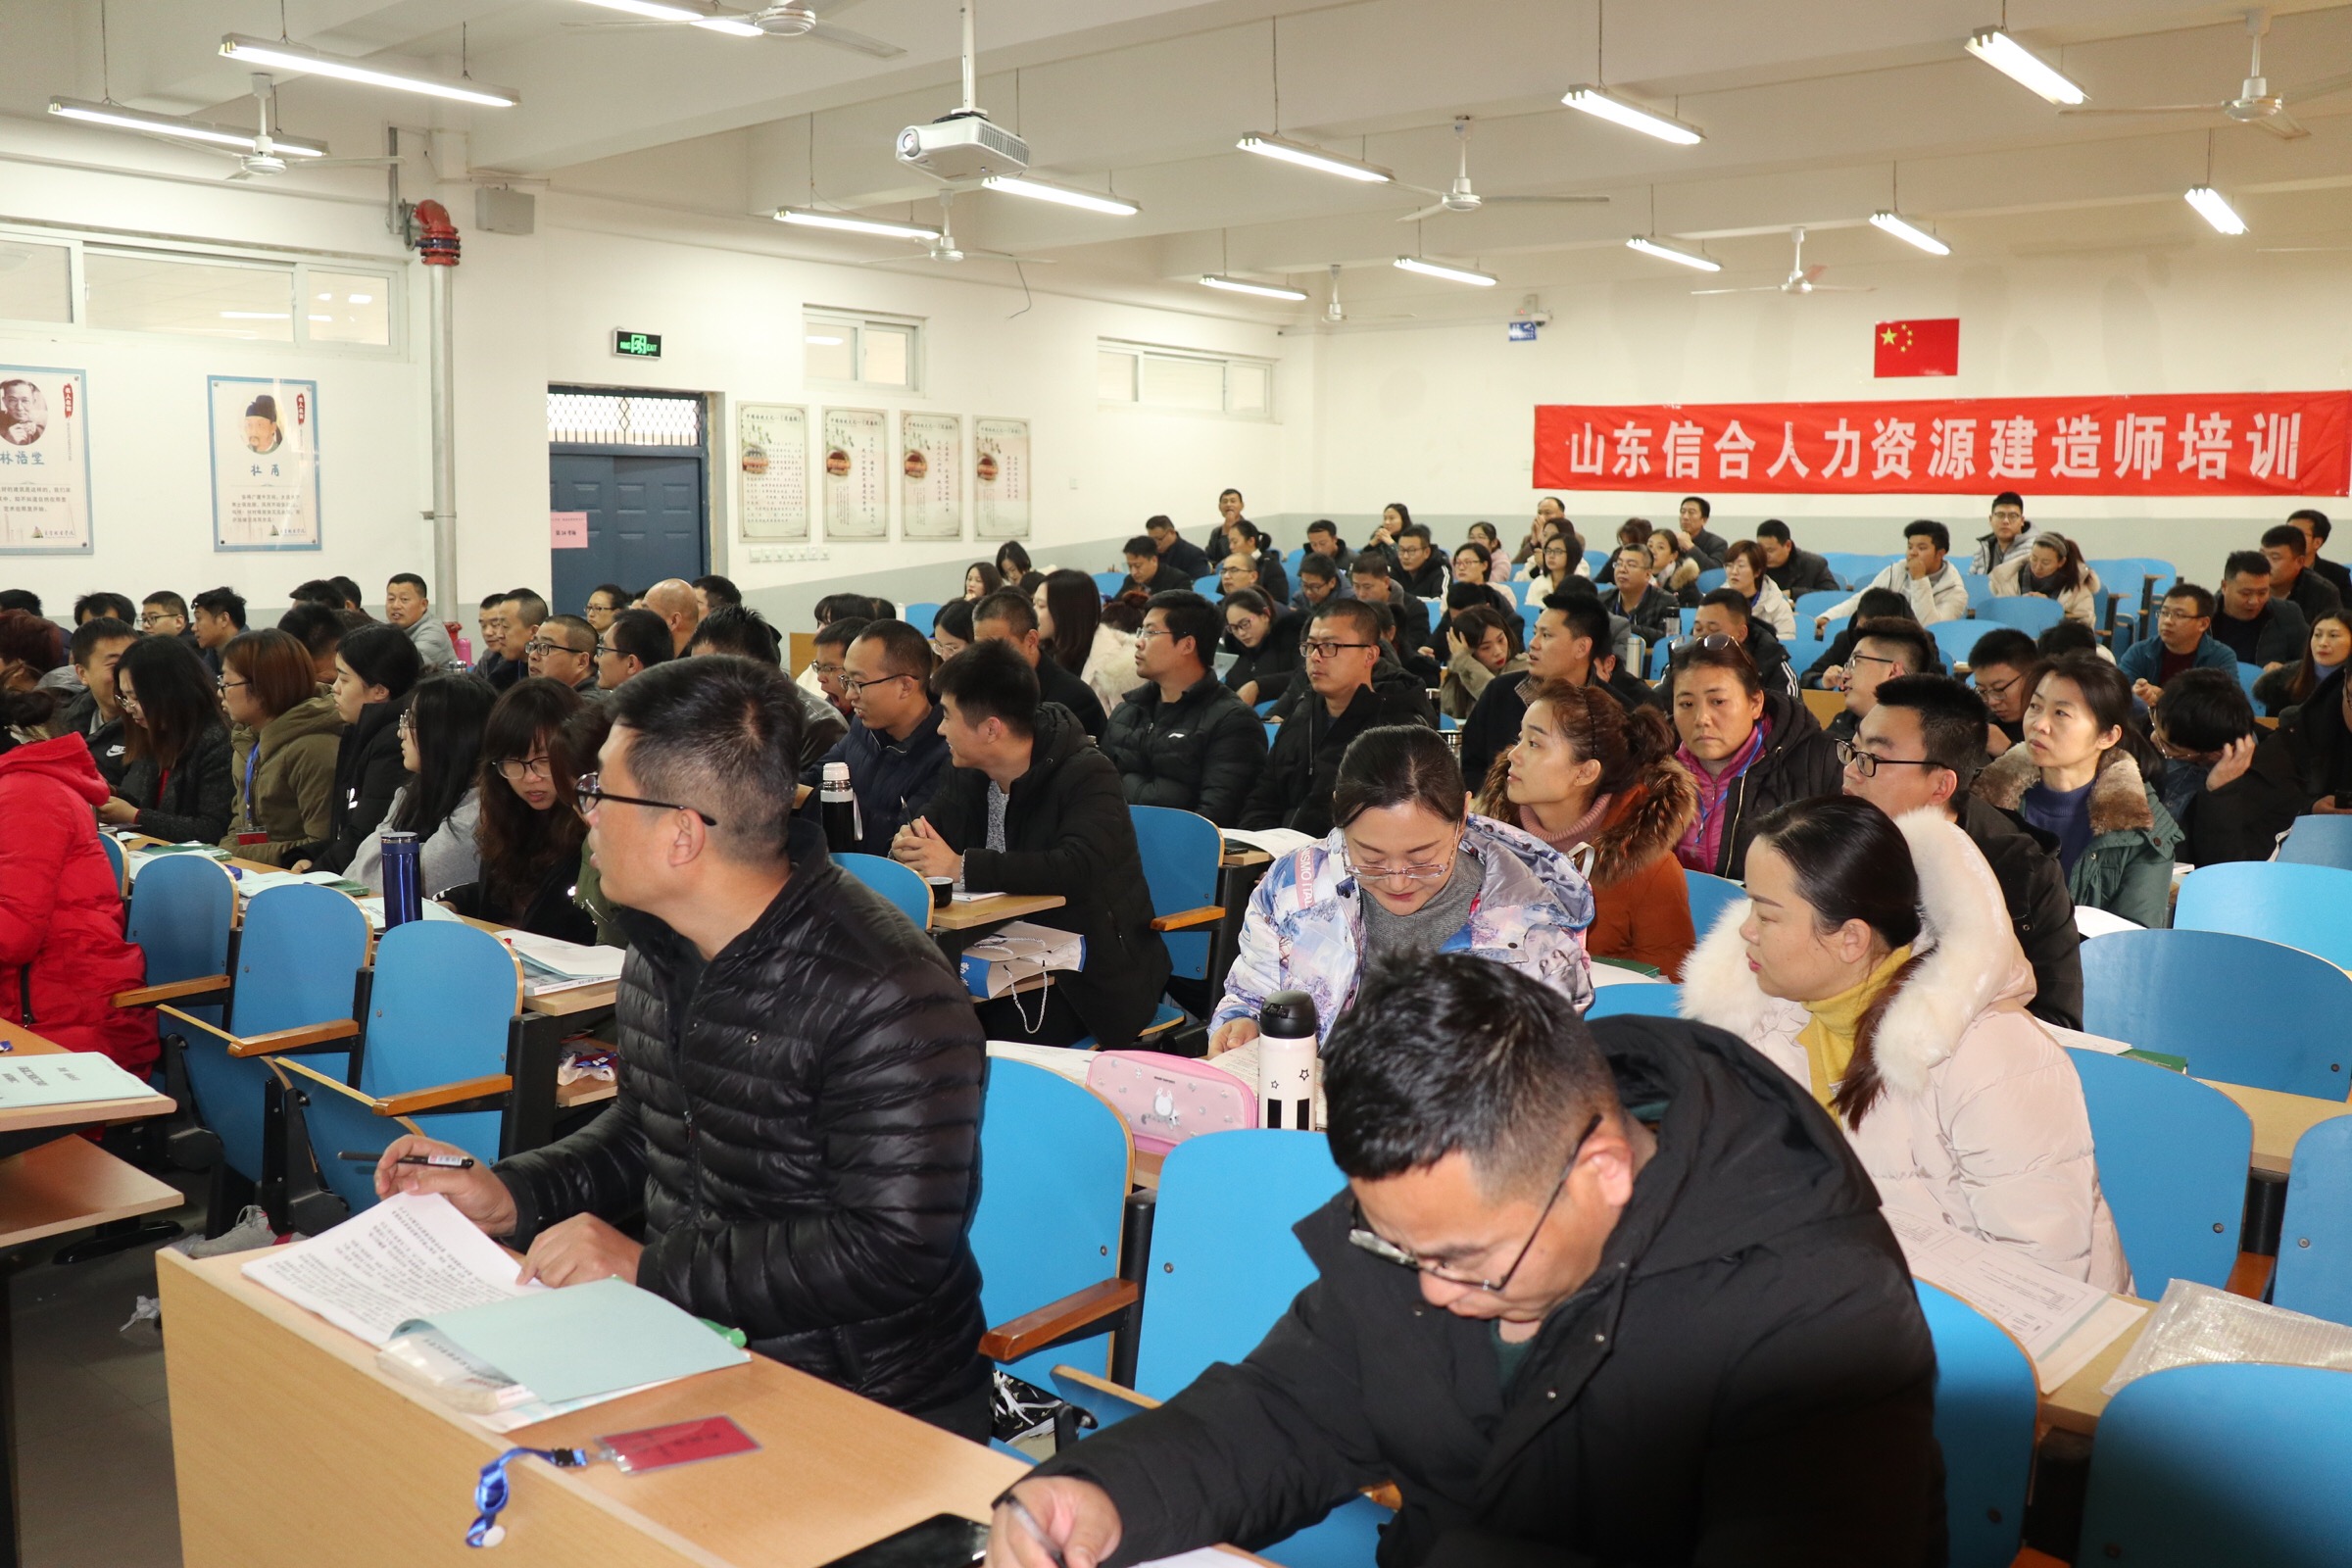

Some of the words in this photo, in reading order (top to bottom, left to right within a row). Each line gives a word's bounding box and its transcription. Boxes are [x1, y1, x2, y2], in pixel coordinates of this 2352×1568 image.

[0, 451, 45, 466] 林语堂
[1569, 412, 2302, 481] 山东信合人力资源建造师培训
